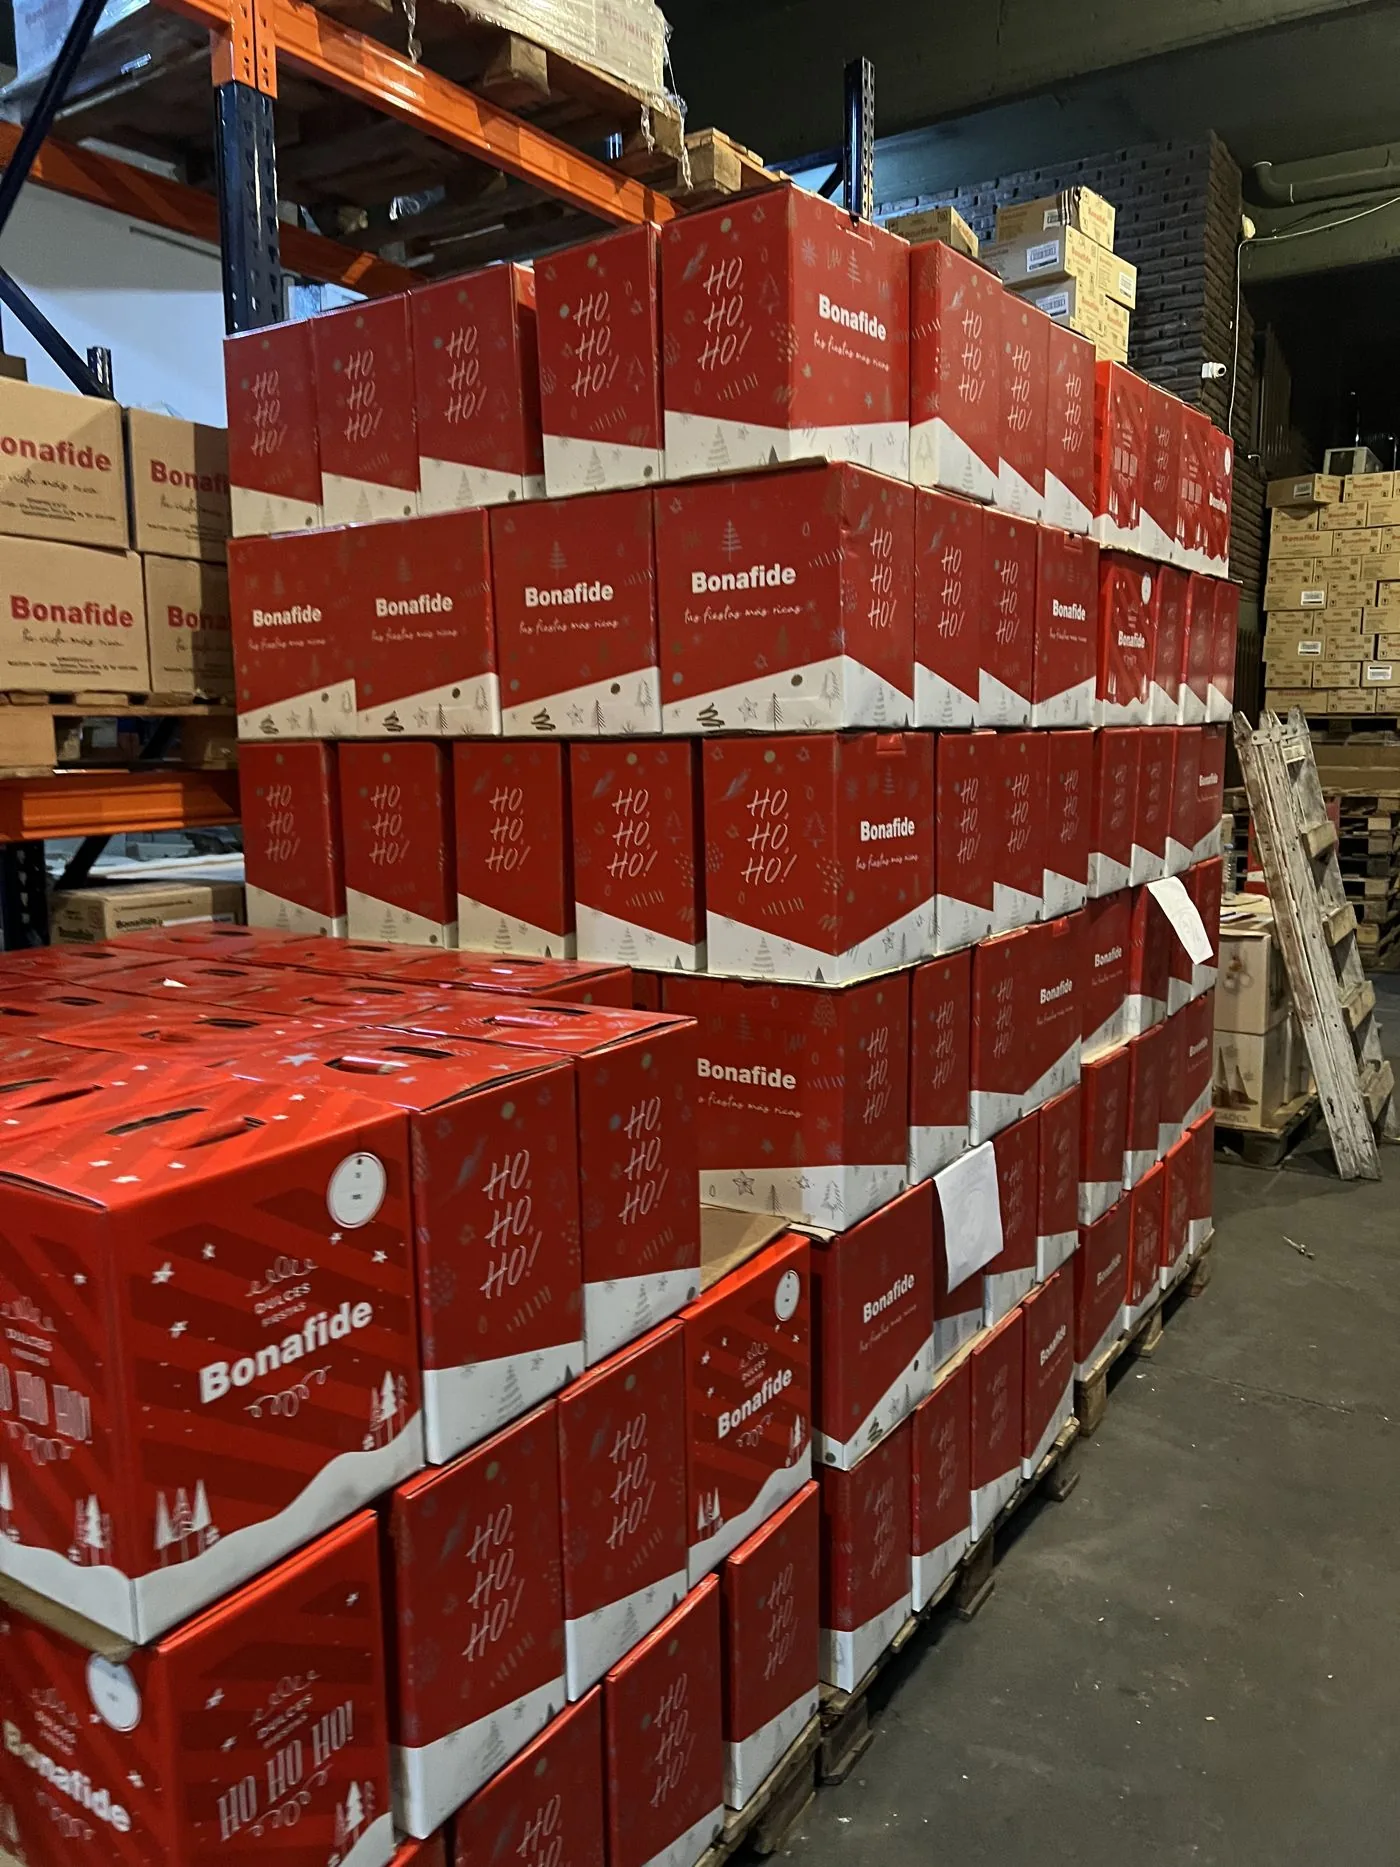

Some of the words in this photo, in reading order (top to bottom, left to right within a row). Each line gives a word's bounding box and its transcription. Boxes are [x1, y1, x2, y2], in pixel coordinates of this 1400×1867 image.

[817, 291, 887, 342] Bonafide
[697, 324, 752, 371] HO!
[571, 354, 620, 397] HO!
[958, 373, 986, 404] HO!
[444, 385, 487, 424] HO!
[1007, 405, 1033, 432] HO!
[251, 424, 288, 457] HO!
[344, 407, 383, 443] HO!
[1062, 429, 1083, 452] HO!
[0, 435, 112, 472] onafide
[525, 581, 614, 608] Bonafide
[691, 563, 797, 594] Bonafide
[10, 595, 134, 629] Bonafide
[252, 604, 322, 627] Bonafide
[375, 593, 453, 618] Bonafide
[867, 598, 897, 630] HO!
[1052, 598, 1086, 622] Bonafide
[937, 610, 966, 639] HO!
[995, 618, 1020, 645] HO!
[860, 816, 916, 842] Bonafide
[1007, 825, 1031, 853] HO!
[265, 837, 301, 863] HO!
[369, 840, 410, 866] HO!
[485, 845, 531, 872] HO!
[607, 850, 658, 879] HO!
[957, 834, 981, 864] HO!
[740, 854, 798, 886] HO!
[696, 1057, 797, 1090] Bonafide
[863, 1083, 893, 1125] HO!
[618, 1168, 670, 1225] HO!
[479, 1230, 543, 1300] HO!
[863, 1273, 915, 1324] Bonafide
[199, 1301, 374, 1404] Bonafide
[718, 1368, 793, 1440] Bonafide
[605, 1480, 657, 1550] HO!
[461, 1577, 525, 1662] HO!
[217, 1775, 258, 1842] HO
[266, 1739, 303, 1803] HO
[311, 1700, 354, 1768] HO!
[650, 1732, 697, 1808] HO!
